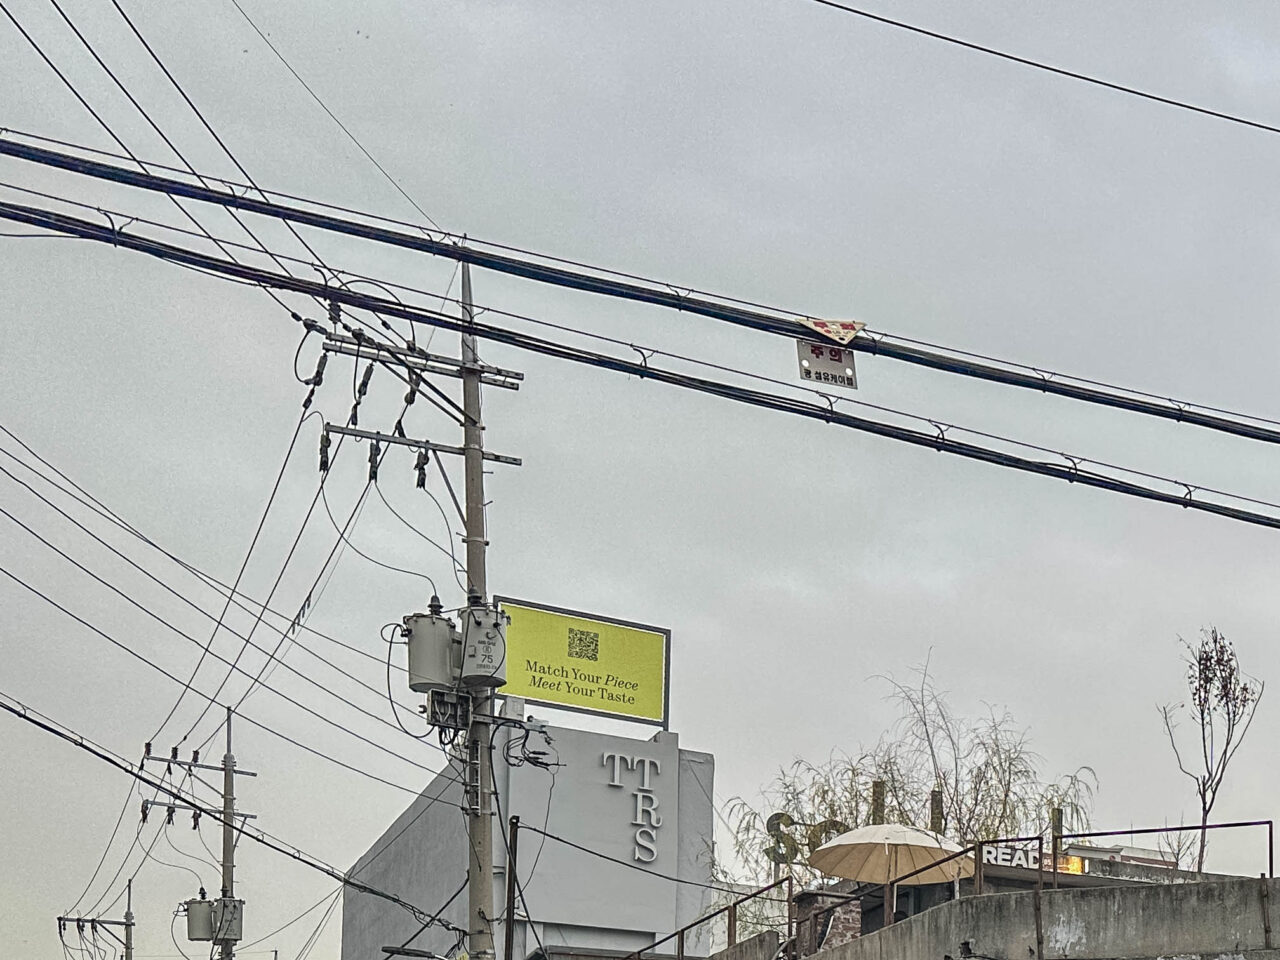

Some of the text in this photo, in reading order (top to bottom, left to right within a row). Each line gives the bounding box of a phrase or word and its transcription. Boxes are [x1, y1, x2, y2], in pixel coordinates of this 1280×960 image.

[811, 344, 843, 363] 주의
[481, 653, 493, 664] 75
[525, 659, 639, 691] Match Your Piece
[528, 675, 635, 705] Meet Your Taste
